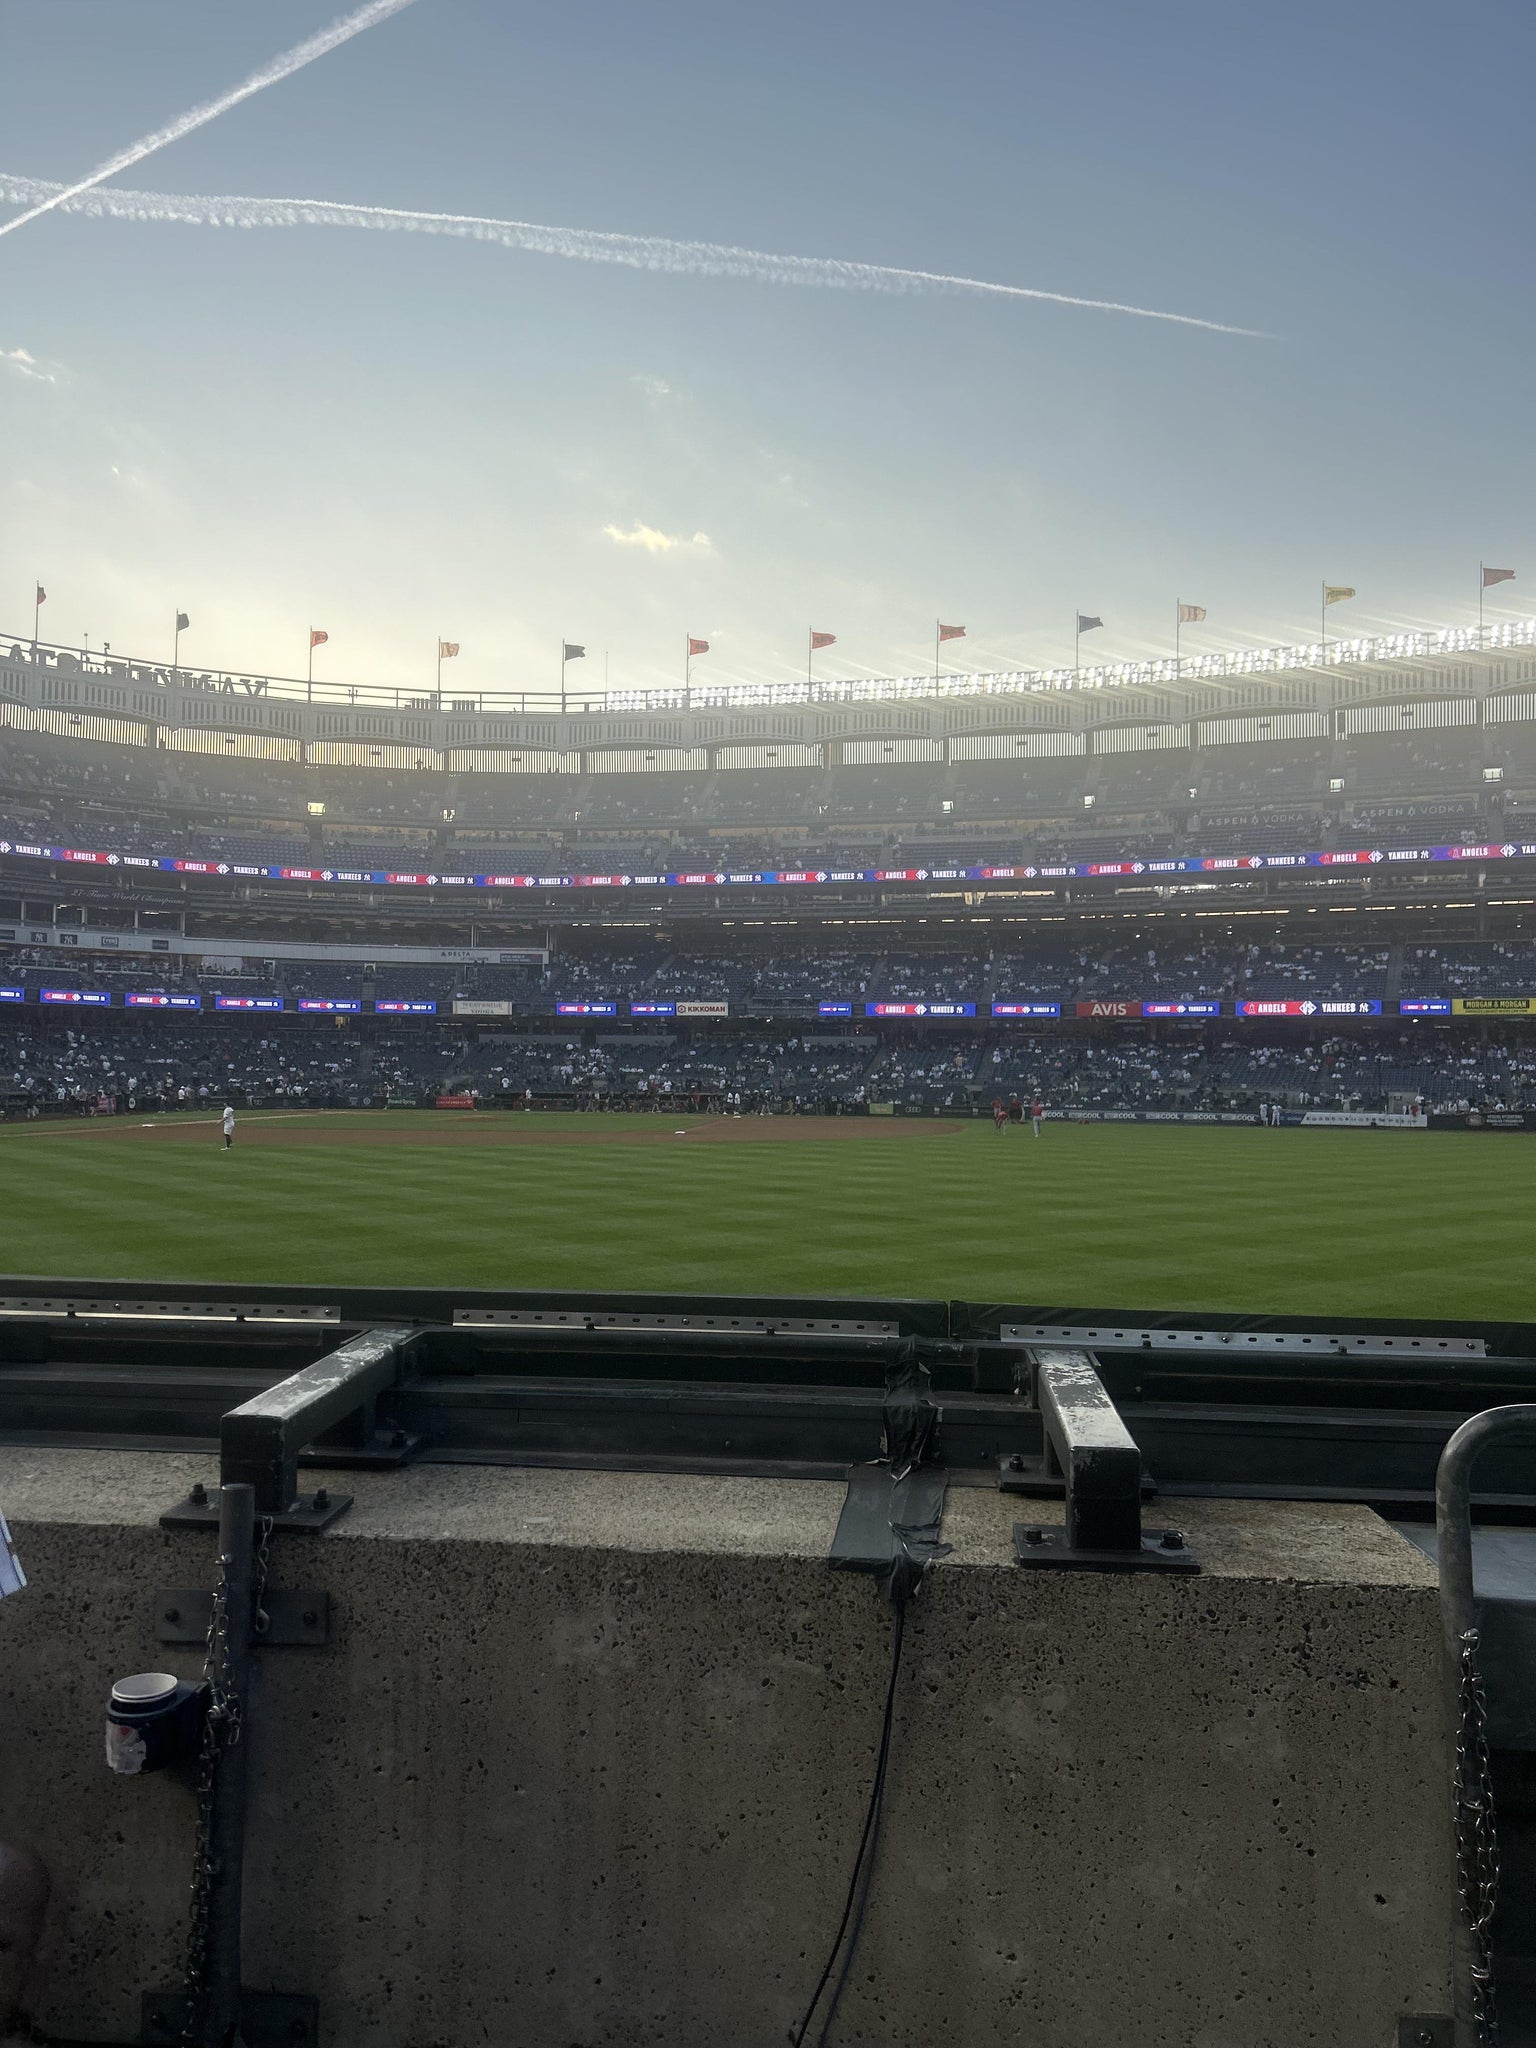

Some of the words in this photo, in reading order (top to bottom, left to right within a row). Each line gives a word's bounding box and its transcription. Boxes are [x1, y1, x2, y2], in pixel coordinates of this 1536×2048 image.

[1360, 808, 1403, 818] ASPEN
[1419, 804, 1465, 815] VODKA
[1207, 816, 1247, 826] ASPEN
[1262, 813, 1304, 823] VODKA
[15, 845, 42, 856] YANKEES
[1461, 848, 1489, 857] ANGELS
[1331, 854, 1357, 863] ANGELS
[1387, 851, 1418, 861] YANKEES
[1213, 860, 1238, 868] ANGELS
[1266, 857, 1296, 866] YANKEES
[1098, 865, 1122, 874] ANGELS
[1148, 863, 1176, 871] YANKEES
[687, 1005, 726, 1013] KIKKOMAN
[1257, 1003, 1287, 1013] ANGELS
[1321, 1003, 1356, 1013] YANKEES
[1466, 1000, 1493, 1008] MORGAN
[1500, 1000, 1527, 1008] MORGAN
[1091, 1003, 1127, 1016] AVIS
[1047, 1111, 1065, 1119] COOL
[1118, 1112, 1137, 1120] COOL
[1198, 1113, 1218, 1121] COOL
[1236, 1114, 1256, 1122] COOL
